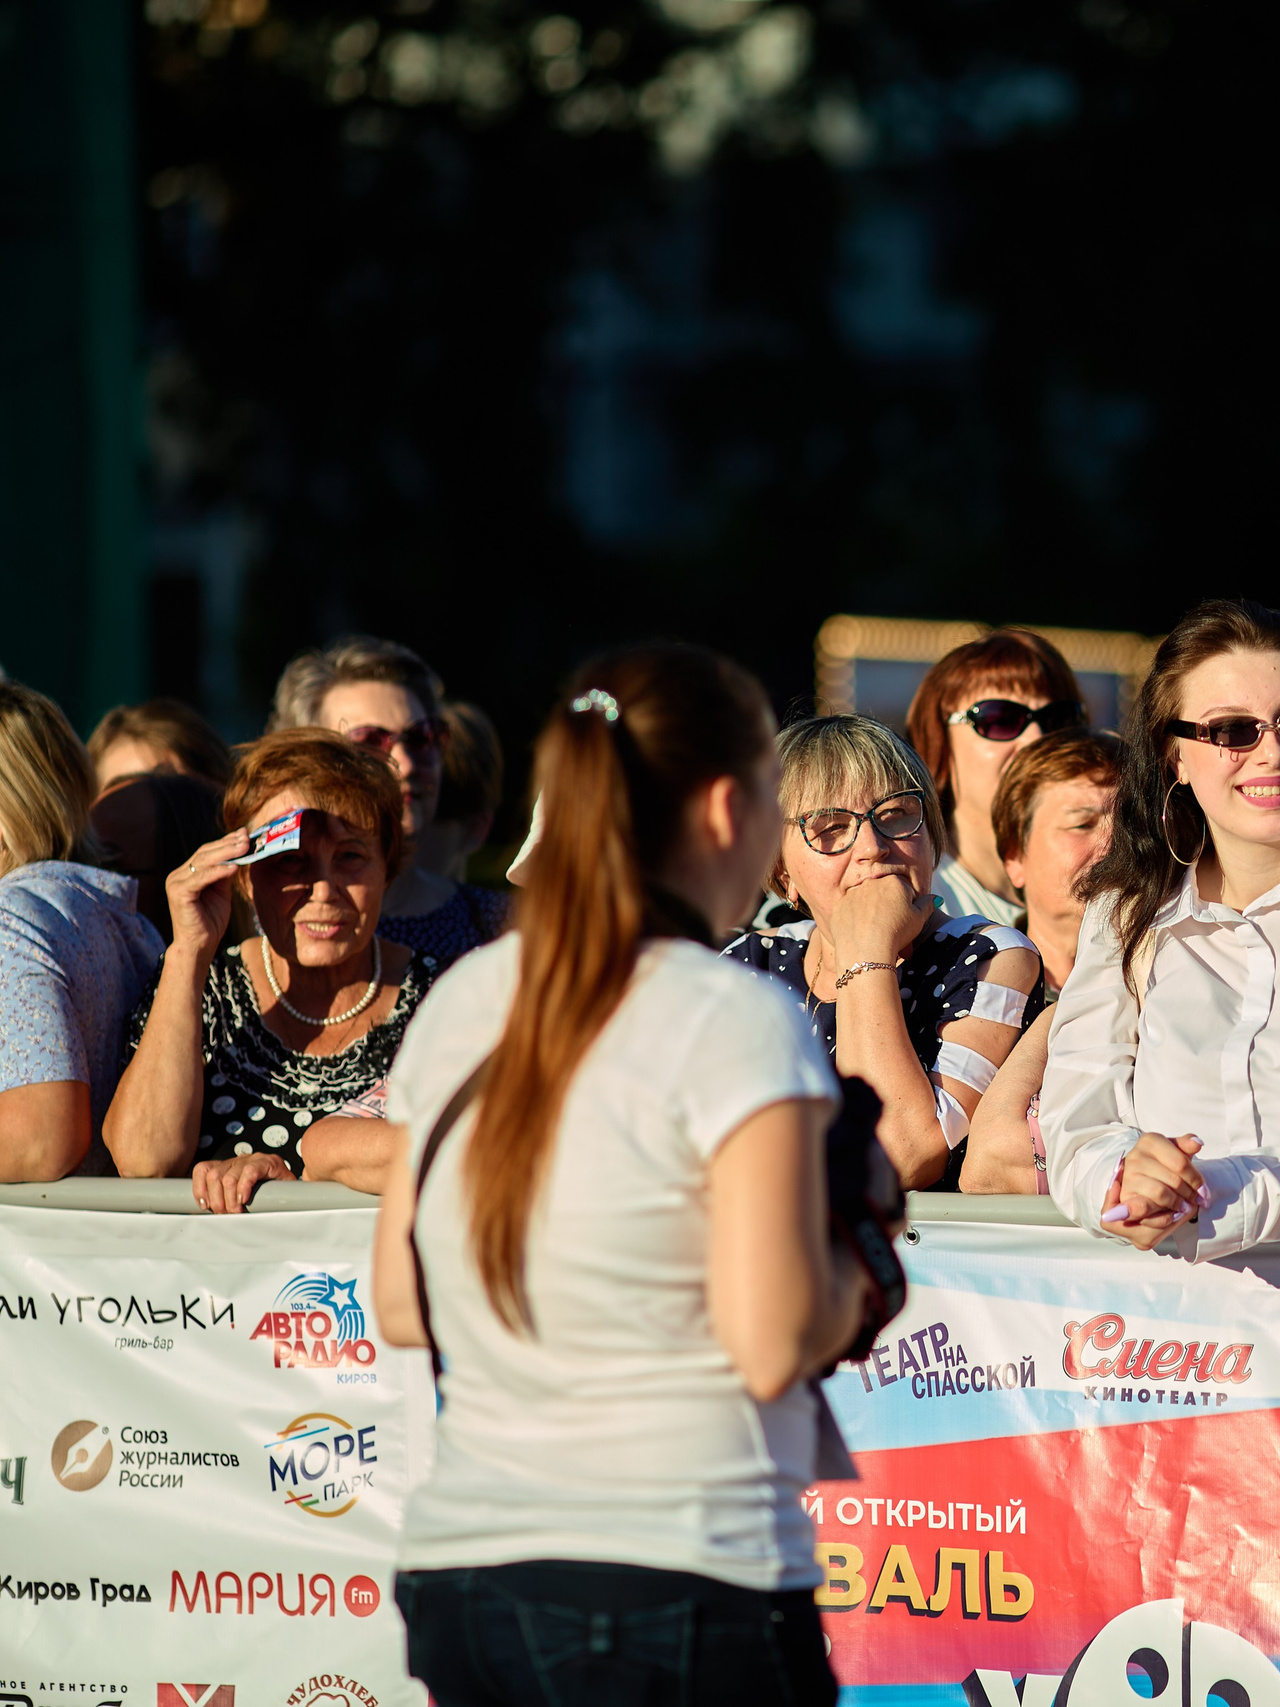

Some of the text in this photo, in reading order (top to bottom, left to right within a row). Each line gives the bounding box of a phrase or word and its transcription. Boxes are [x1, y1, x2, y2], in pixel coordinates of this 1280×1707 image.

[249, 1311, 332, 1340] АВТО
[114, 1335, 174, 1352] гриль-бар
[273, 1339, 376, 1369] РАДИО
[850, 1322, 950, 1394] ТЕАТР
[942, 1344, 968, 1369] НА
[1062, 1312, 1255, 1384] Смена
[336, 1373, 377, 1385] КИРОВ
[911, 1355, 1036, 1399] СПАССКОЙ
[1084, 1385, 1229, 1407] КИНОТЕАТР
[120, 1426, 169, 1444] Союз
[119, 1450, 240, 1469] журналистов
[269, 1425, 378, 1492] МОРЕ
[118, 1470, 184, 1488] России
[323, 1471, 374, 1501] ПАРК
[836, 1496, 1027, 1535] ОТКРЫТЫЙ
[90, 1577, 152, 1607] Град
[168, 1569, 374, 1617] МАРИЯ fm
[39, 1682, 128, 1694] АГЕНТСТВО
